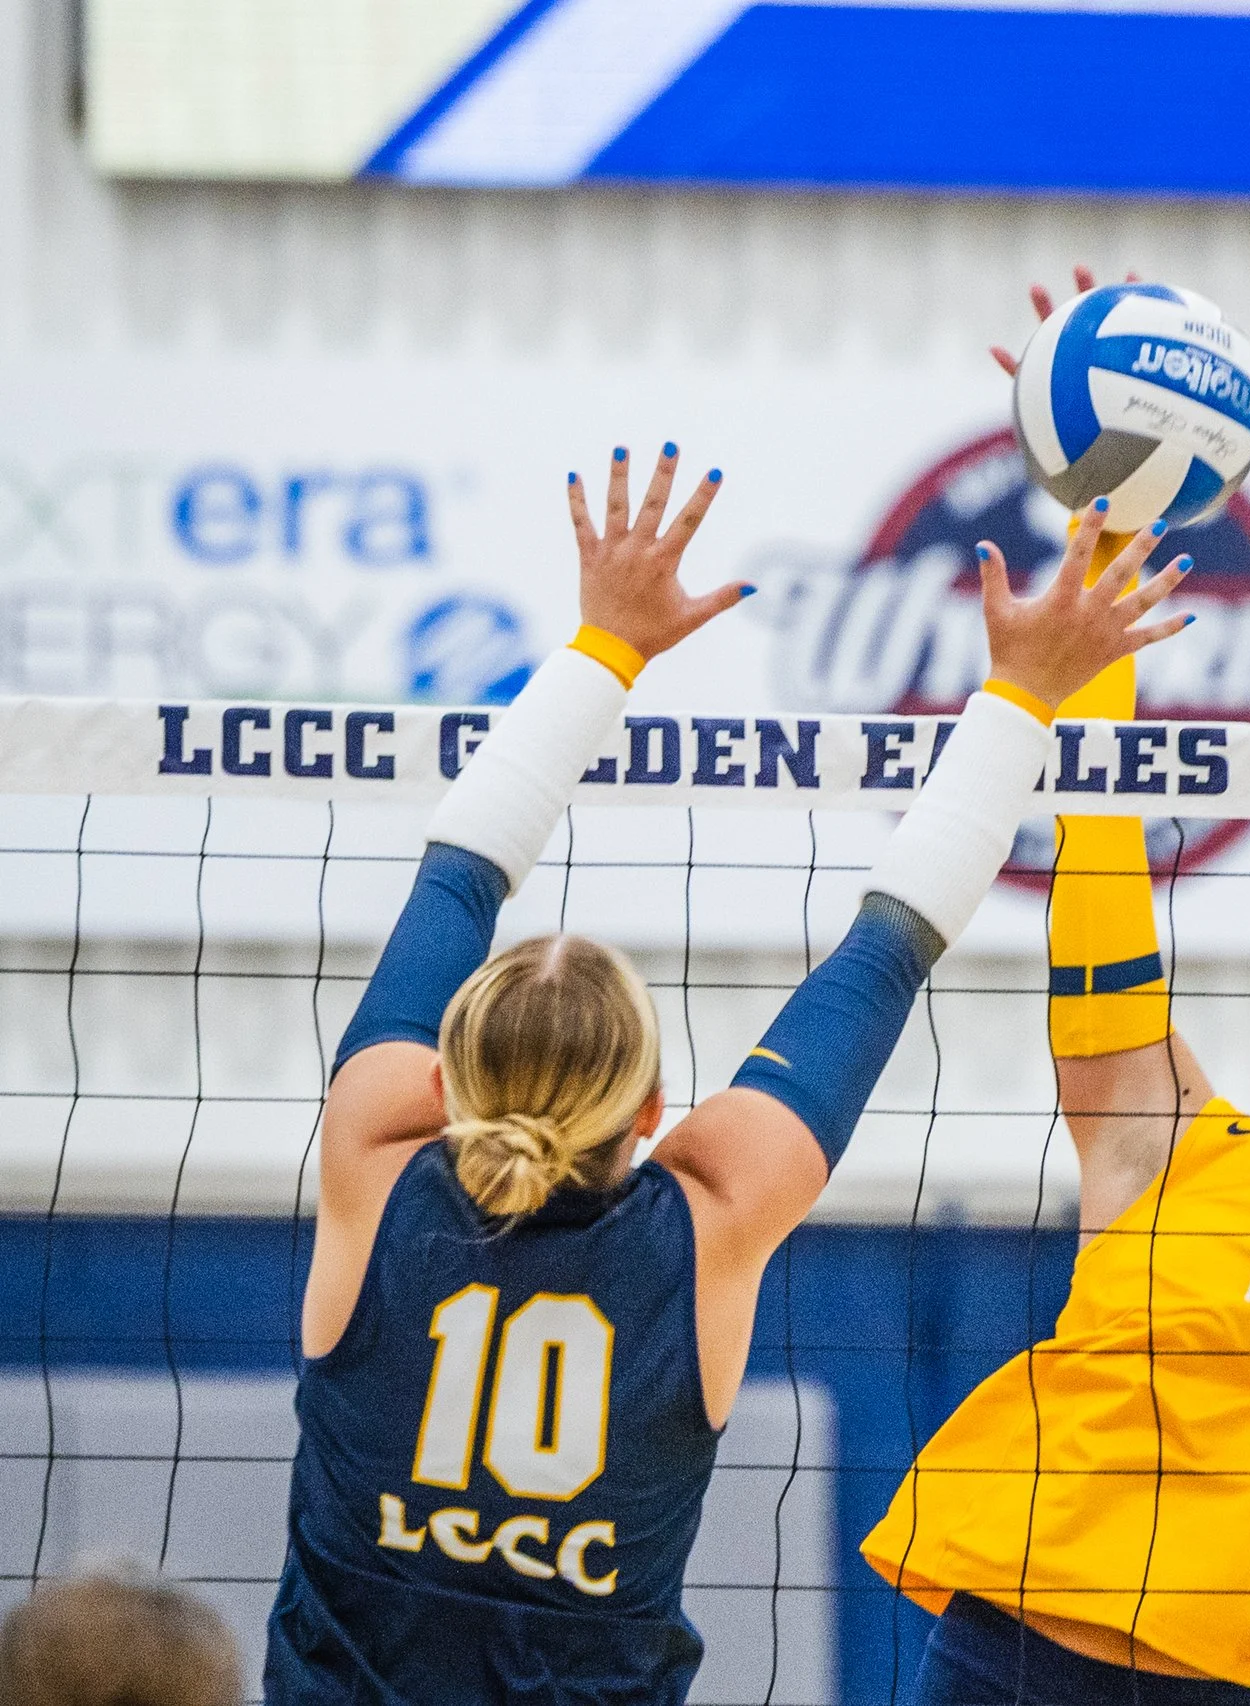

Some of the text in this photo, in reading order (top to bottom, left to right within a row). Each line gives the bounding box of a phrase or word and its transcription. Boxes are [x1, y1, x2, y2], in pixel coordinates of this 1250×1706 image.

[158, 704, 1229, 796] LCCC GDEN ELES
[411, 1282, 615, 1502] 10
[377, 1494, 620, 1597] LCCC
